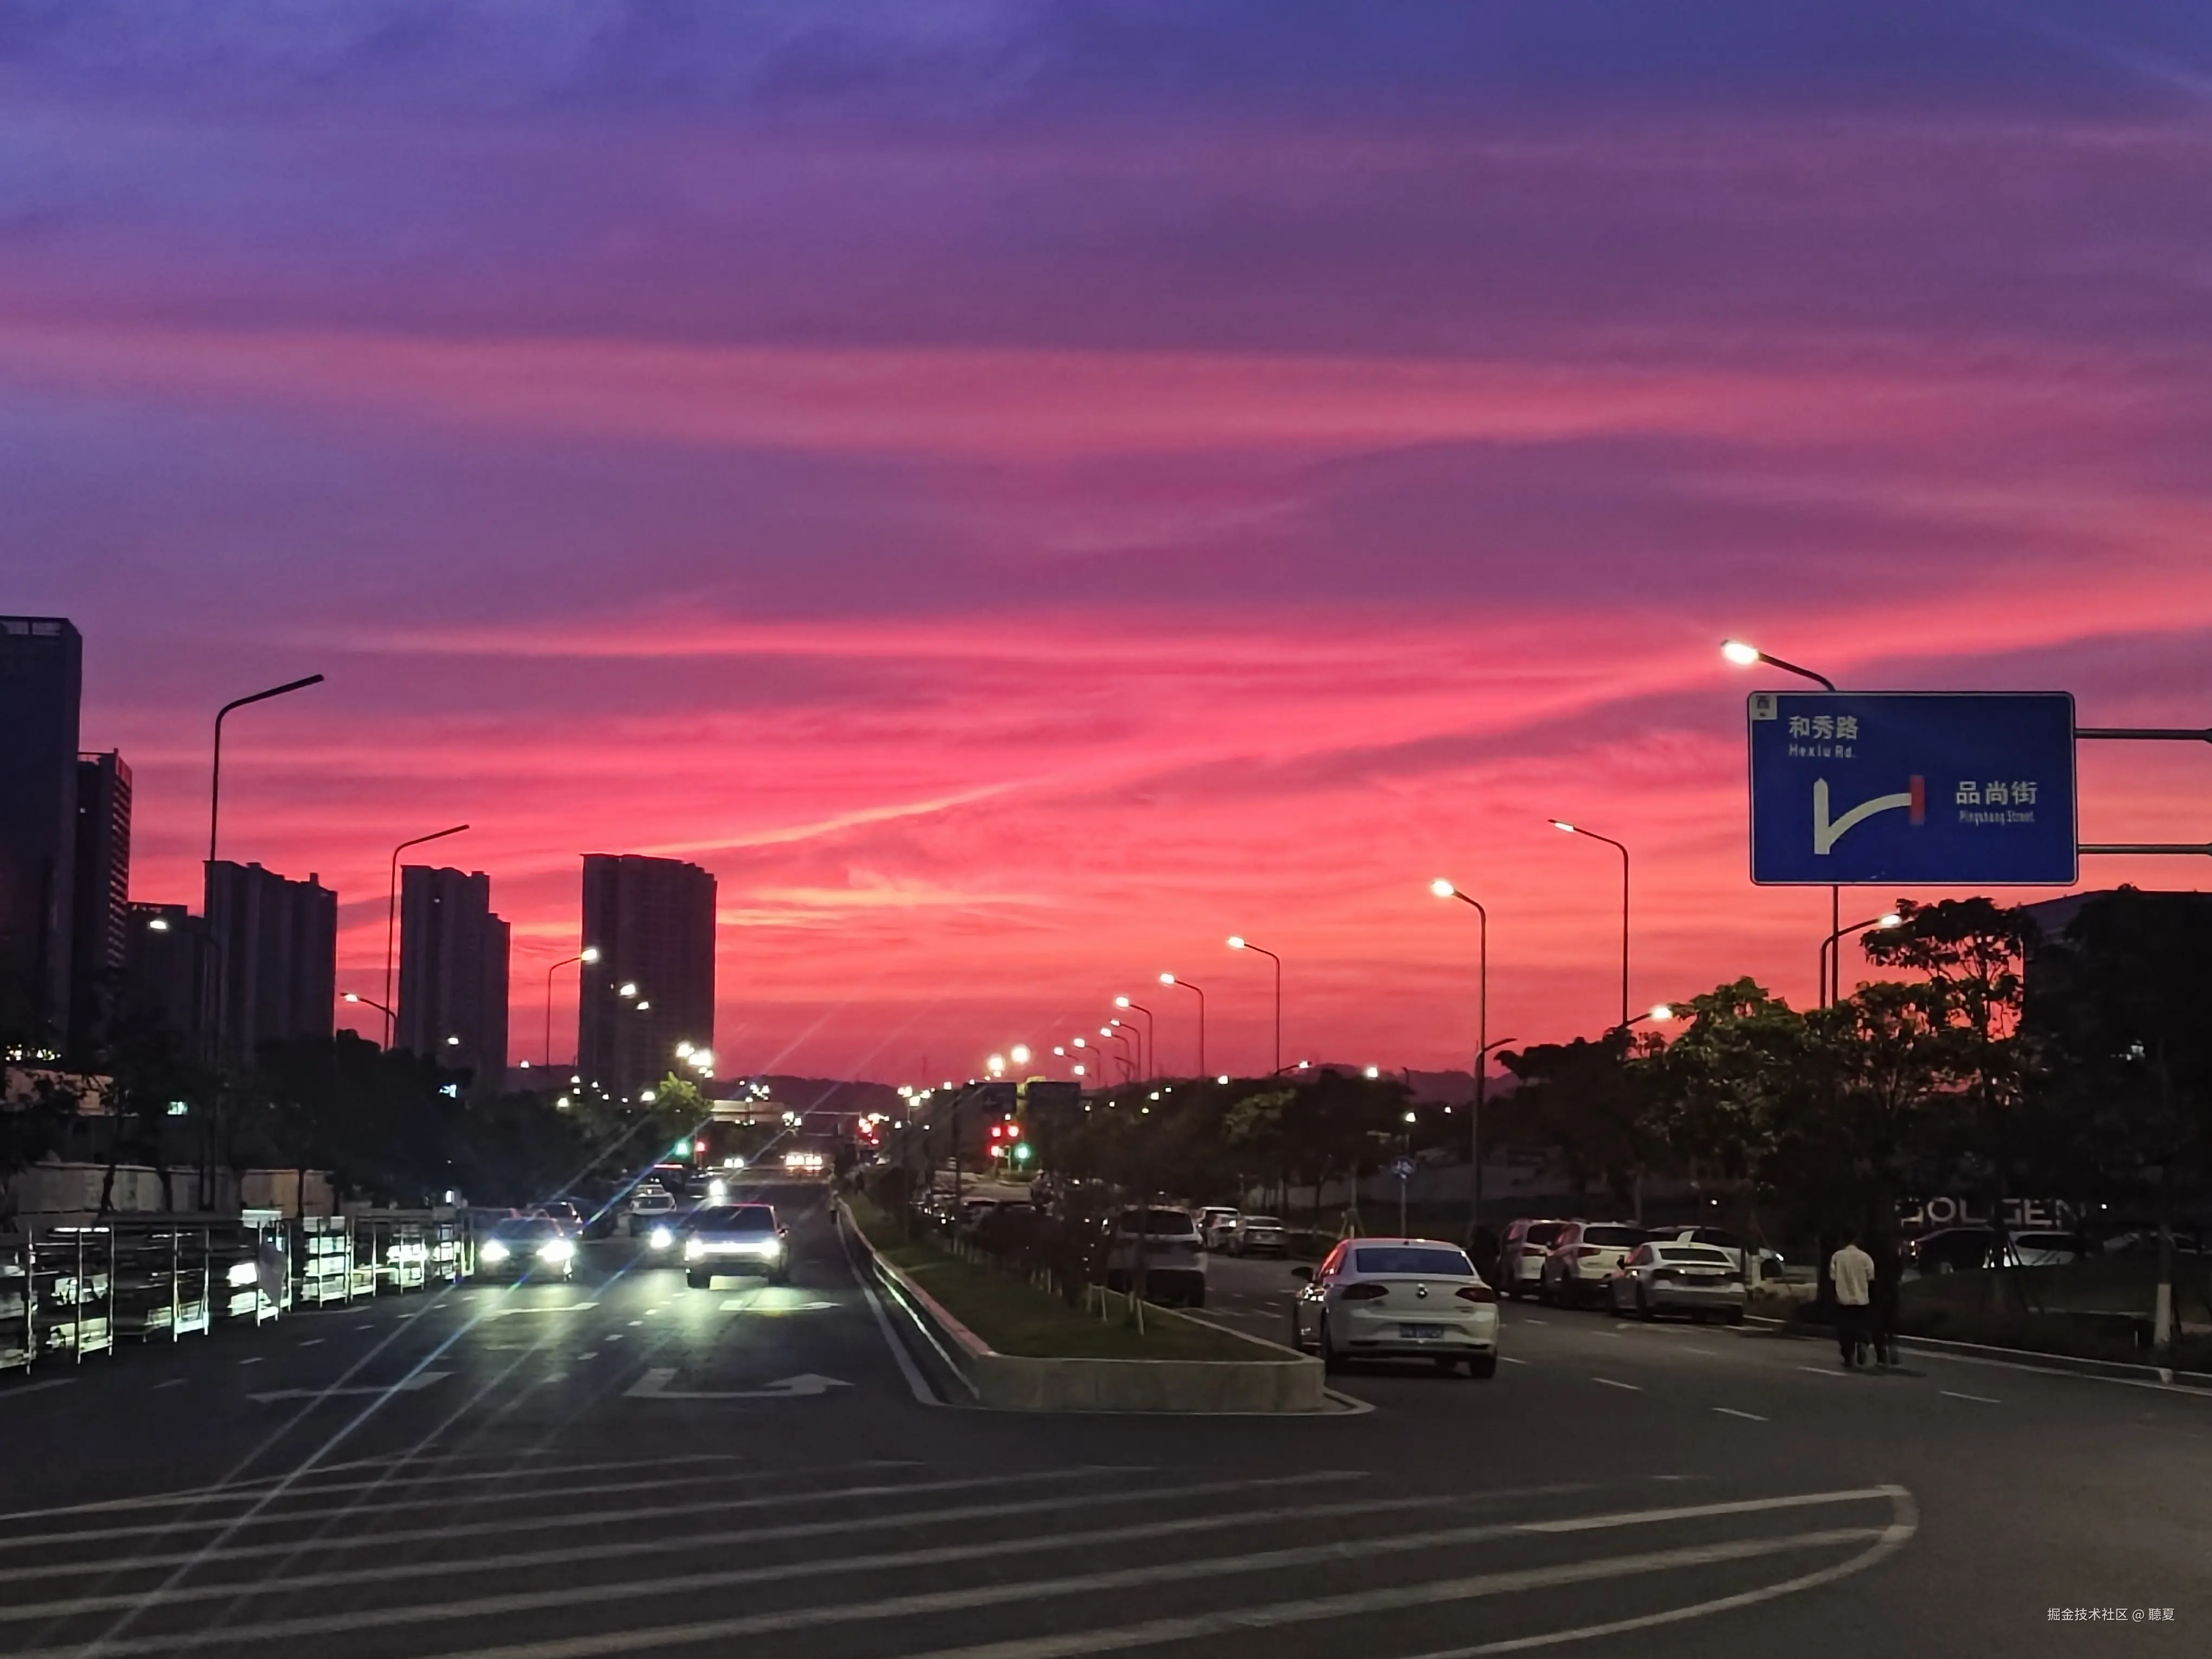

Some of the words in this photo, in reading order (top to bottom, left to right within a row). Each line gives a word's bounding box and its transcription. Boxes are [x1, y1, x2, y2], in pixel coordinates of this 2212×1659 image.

[1789, 716, 1858, 740] 和秀路
[1789, 743, 1831, 757] Hexiu
[1956, 781, 2038, 805] 品尚街
